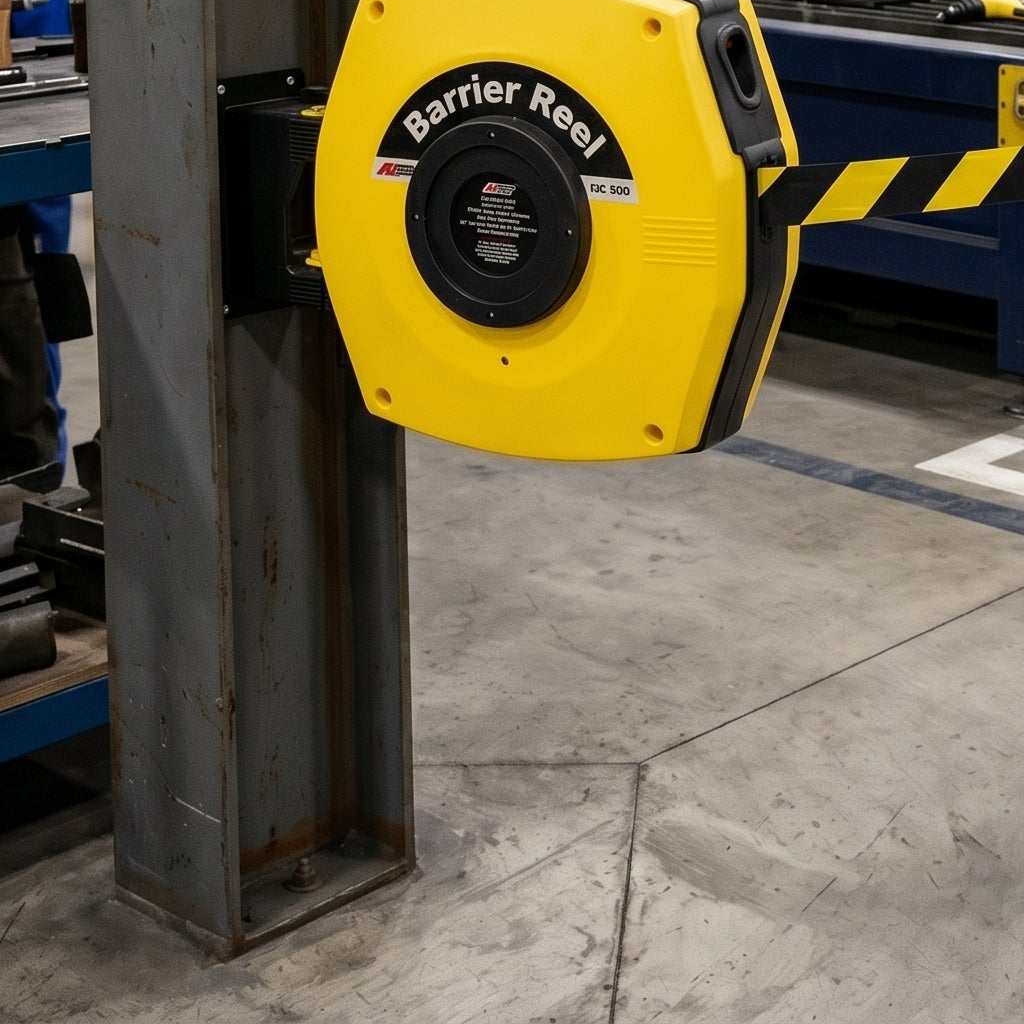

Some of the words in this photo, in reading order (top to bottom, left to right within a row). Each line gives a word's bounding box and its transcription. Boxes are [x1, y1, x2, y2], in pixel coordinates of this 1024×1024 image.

[402, 73, 522, 144] Barrier
[528, 82, 607, 160] Reel
[609, 185, 630, 196] 500
